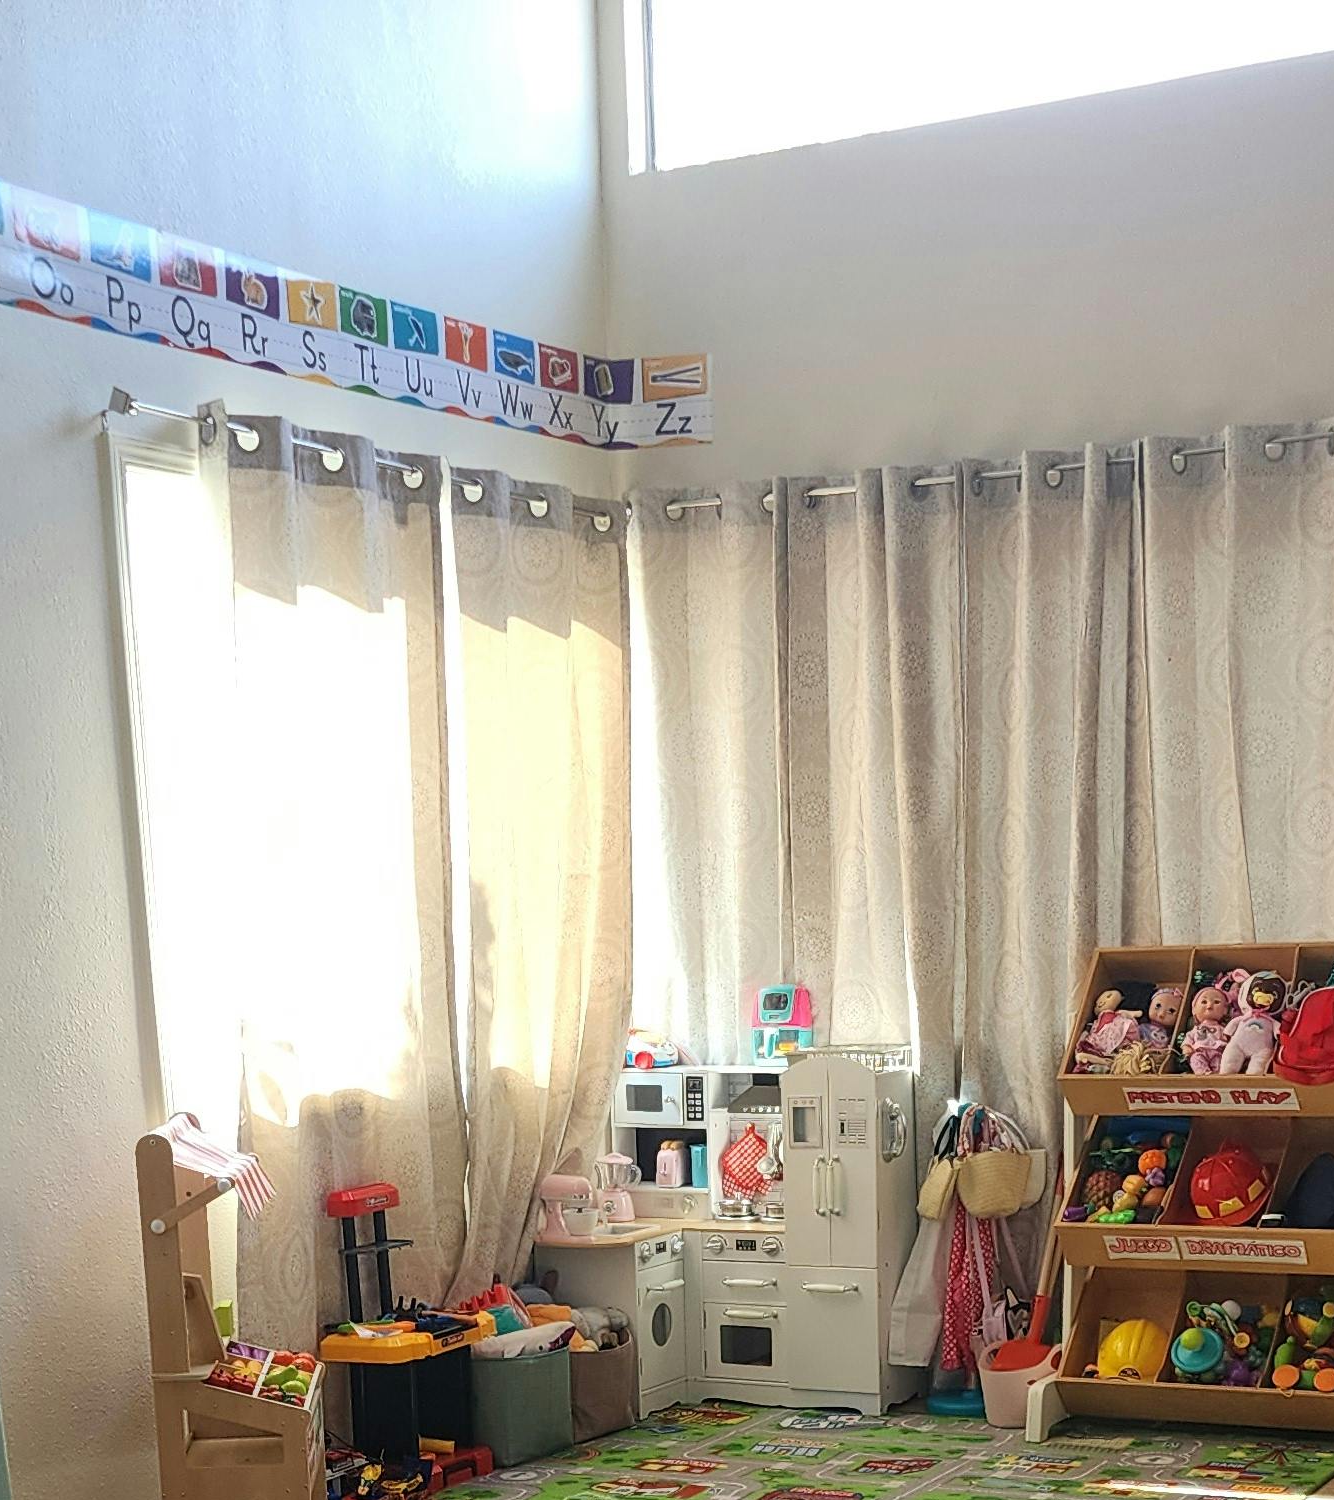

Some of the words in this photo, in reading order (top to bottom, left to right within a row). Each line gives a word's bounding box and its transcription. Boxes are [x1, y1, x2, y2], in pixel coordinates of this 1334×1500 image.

[31, 256, 74, 305] Oo
[106, 276, 141, 331] Pp
[171, 295, 211, 348] Qq
[241, 313, 269, 357] Rr
[302, 331, 327, 371] Ss
[354, 343, 379, 384] Tt
[404, 356, 433, 397] Uu
[456, 369, 481, 408] Vv
[499, 380, 533, 421] Ww
[548, 393, 573, 430] Xx
[591, 404, 619, 441] Yy
[656, 402, 693, 436] Zz
[1127, 1090, 1222, 1105] PRETEND
[1230, 1090, 1292, 1105] PLAY
